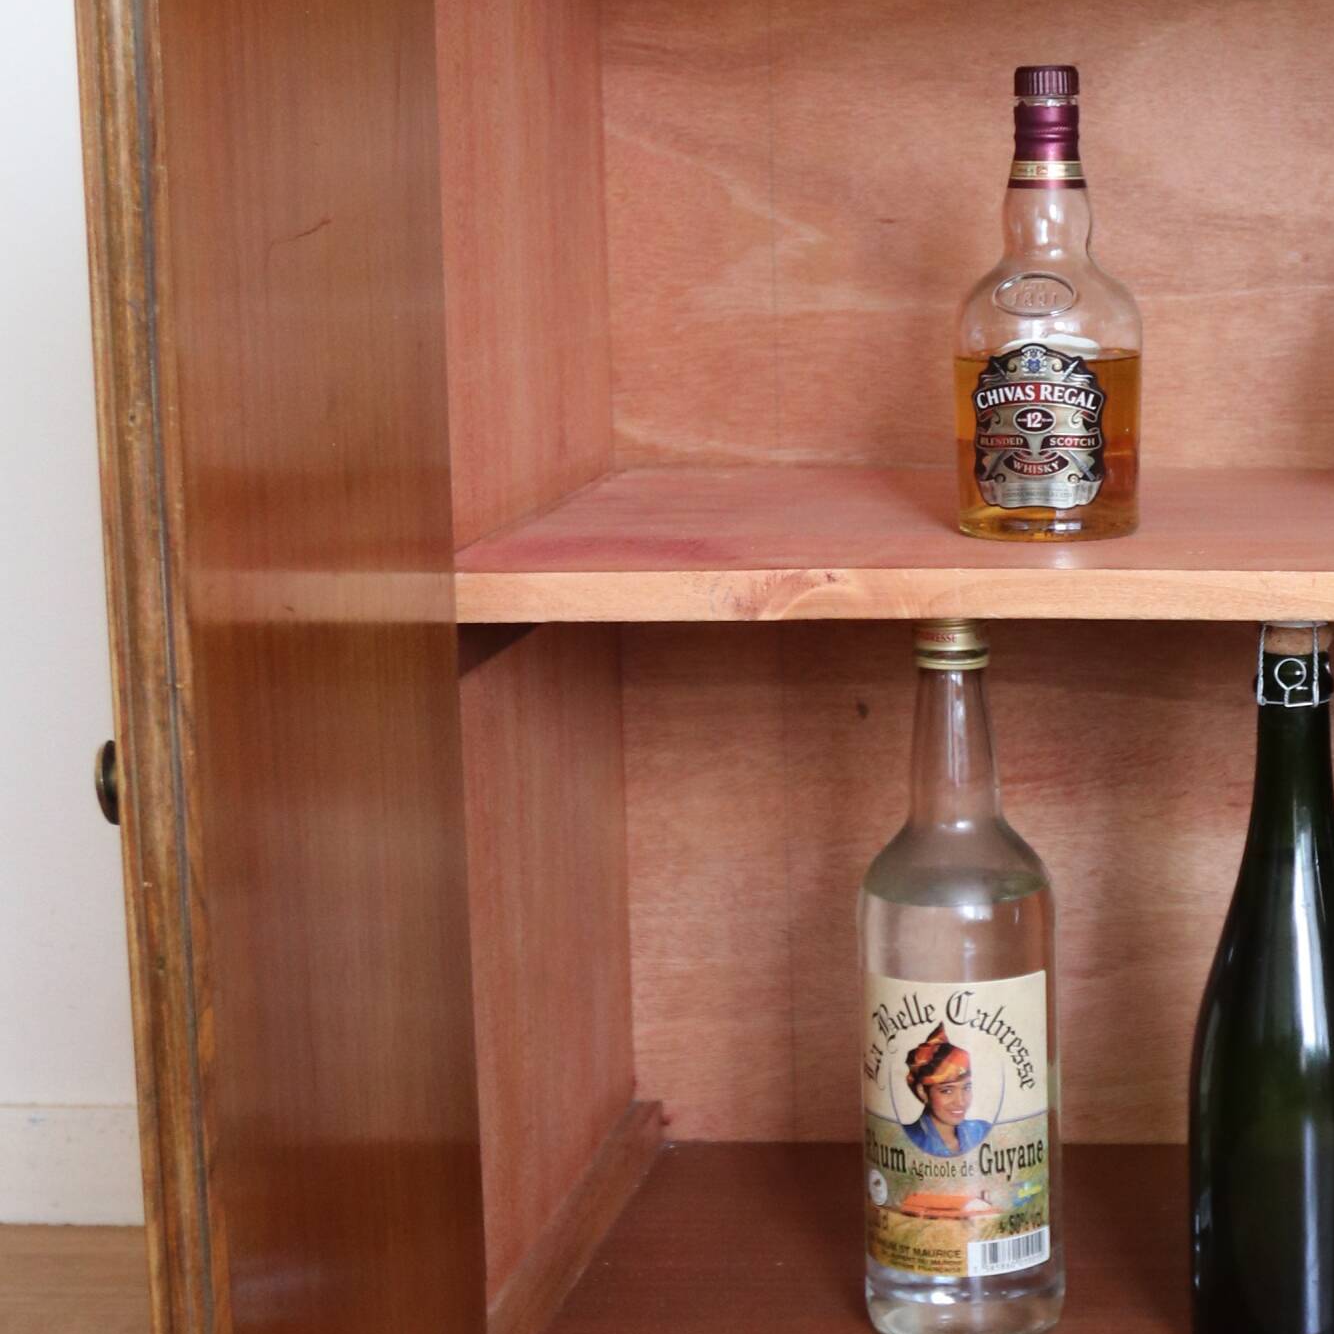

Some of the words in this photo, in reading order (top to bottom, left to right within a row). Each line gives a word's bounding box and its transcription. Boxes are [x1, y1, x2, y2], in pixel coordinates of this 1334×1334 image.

[976, 384, 1035, 410] CHIVAS
[1039, 384, 1097, 411] REGAL
[1026, 412, 1042, 428] 12
[980, 436, 1024, 447] BLENDED
[1049, 437, 1096, 447] SCOTCH
[1013, 460, 1060, 474] WHISKY
[872, 991, 936, 1055] Belle
[945, 990, 1036, 1091] Cabresse
[911, 1159, 956, 1181] Agricole
[960, 1162, 975, 1177] de
[979, 1138, 1044, 1181] Guyane
[912, 1247, 962, 1259] MAURICE
